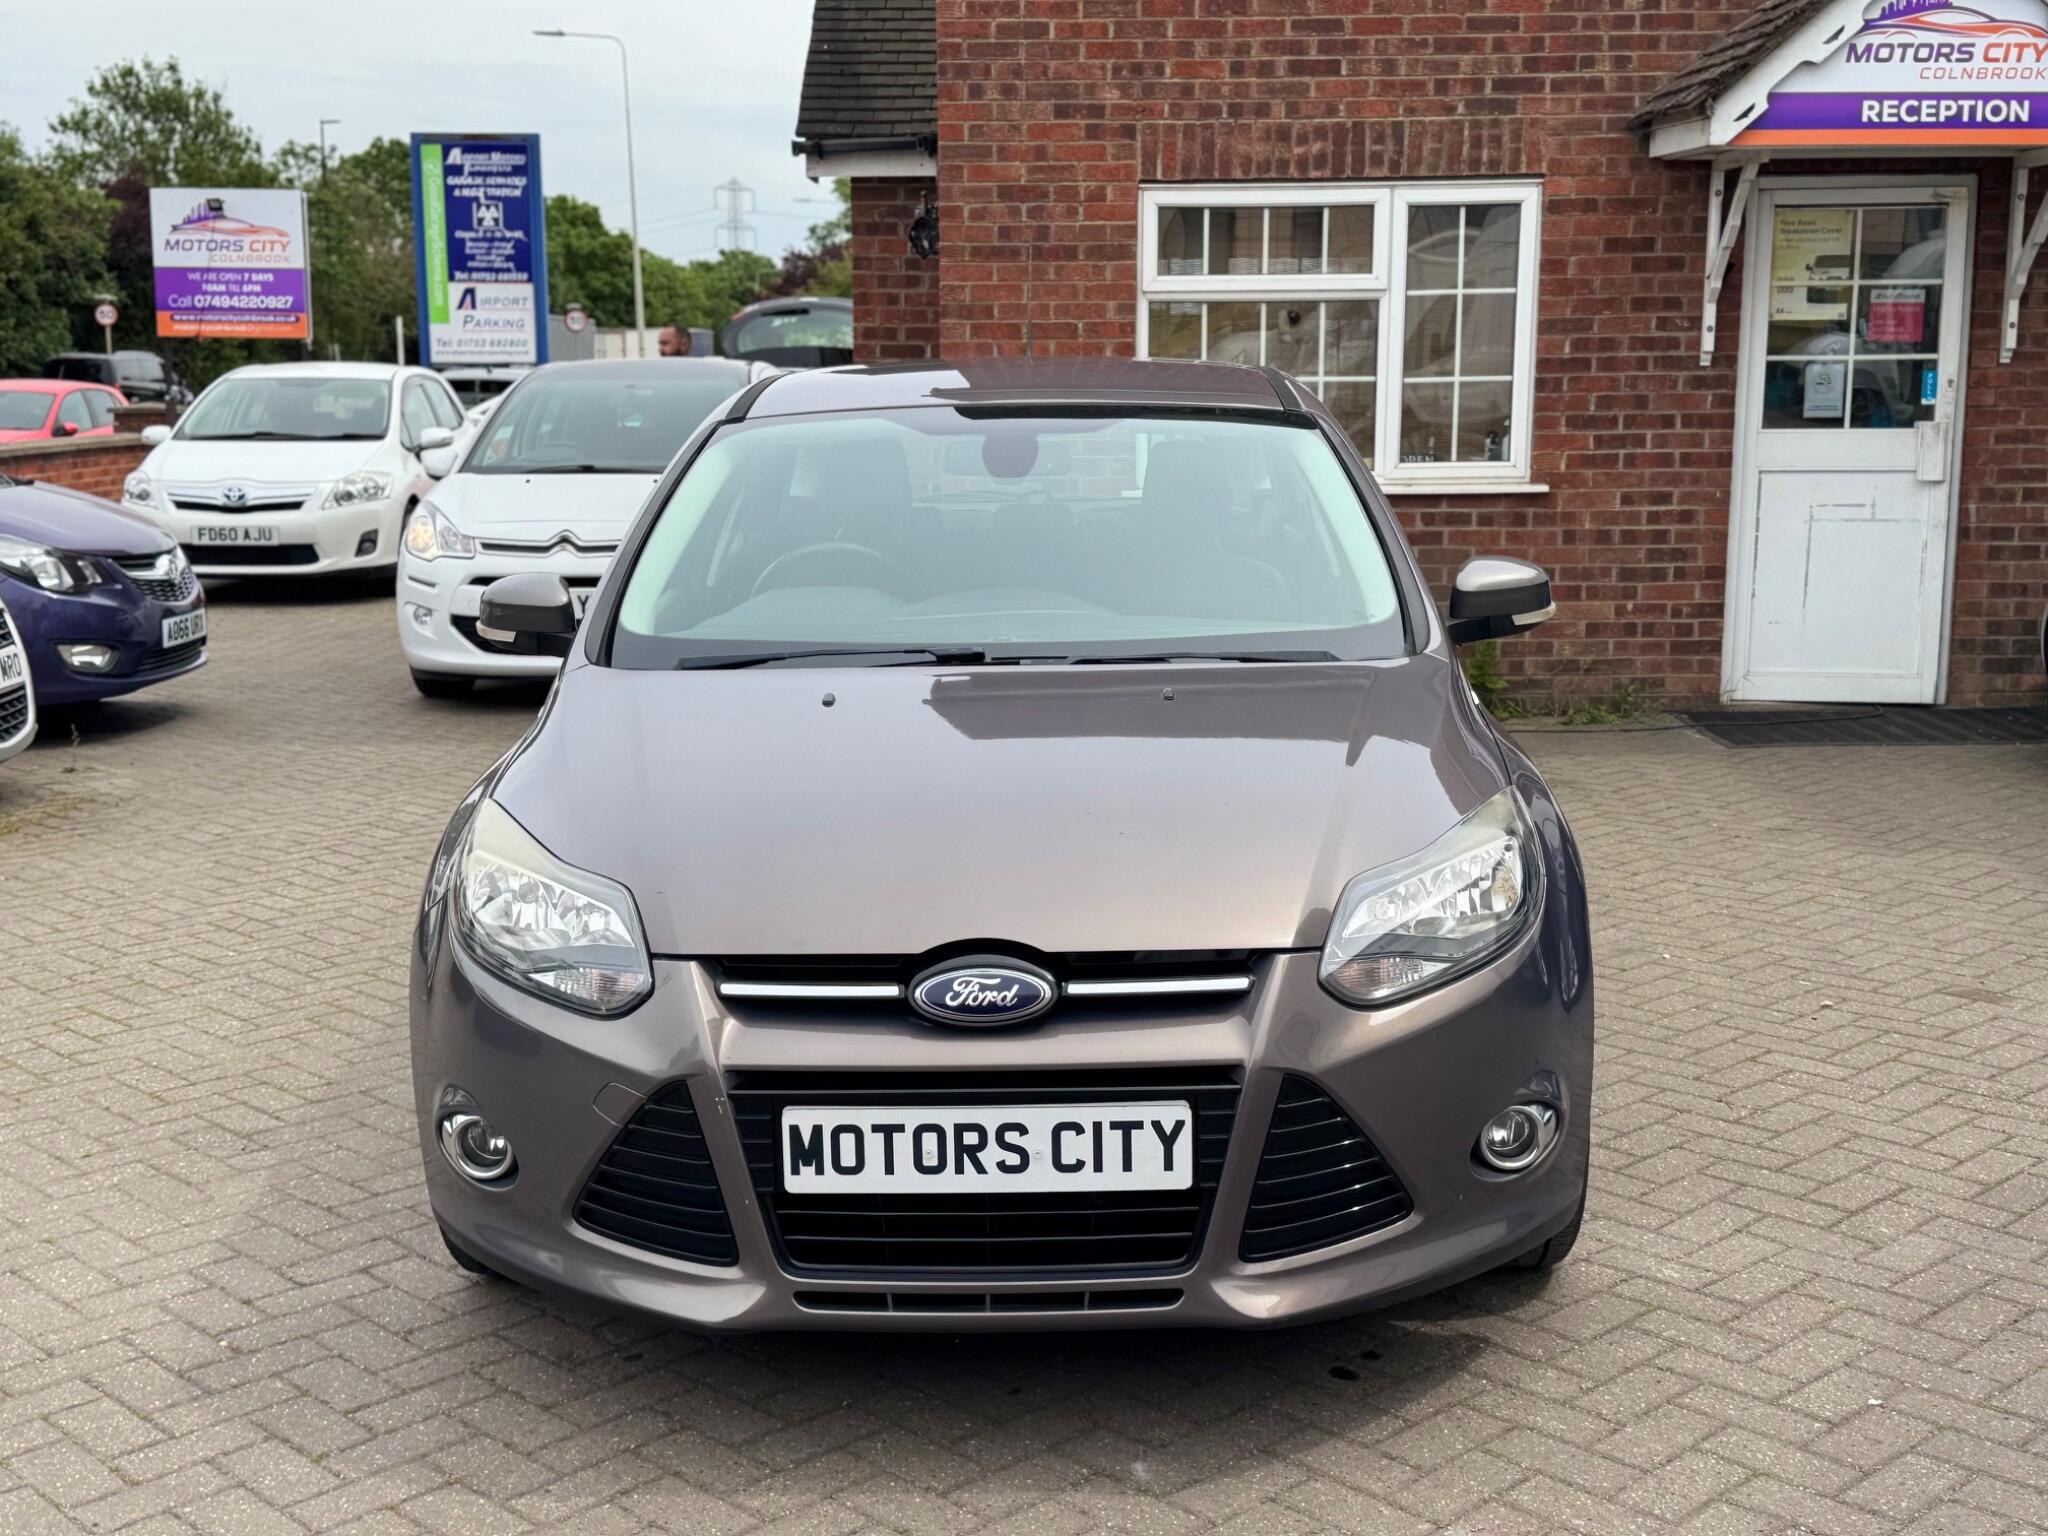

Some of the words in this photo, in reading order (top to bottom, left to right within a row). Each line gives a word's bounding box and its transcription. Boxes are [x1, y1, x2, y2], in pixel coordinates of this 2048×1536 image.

[1846, 42, 1976, 63] MOTORS
[1982, 42, 2048, 63] CITY
[1919, 67, 2047, 80] COLNBROOK
[1861, 100, 2030, 123] RECEPTION
[164, 239, 245, 252] MOTORS
[249, 240, 291, 252] CITY
[168, 294, 192, 307] Call
[194, 295, 293, 308] 07494220927
[463, 315, 525, 328] PARKING
[198, 527, 238, 541] FD60
[243, 527, 272, 541] AJU
[945, 976, 1019, 1007] Ford
[788, 1121, 1031, 1176] MOTORS
[1050, 1119, 1186, 1174] CITY
